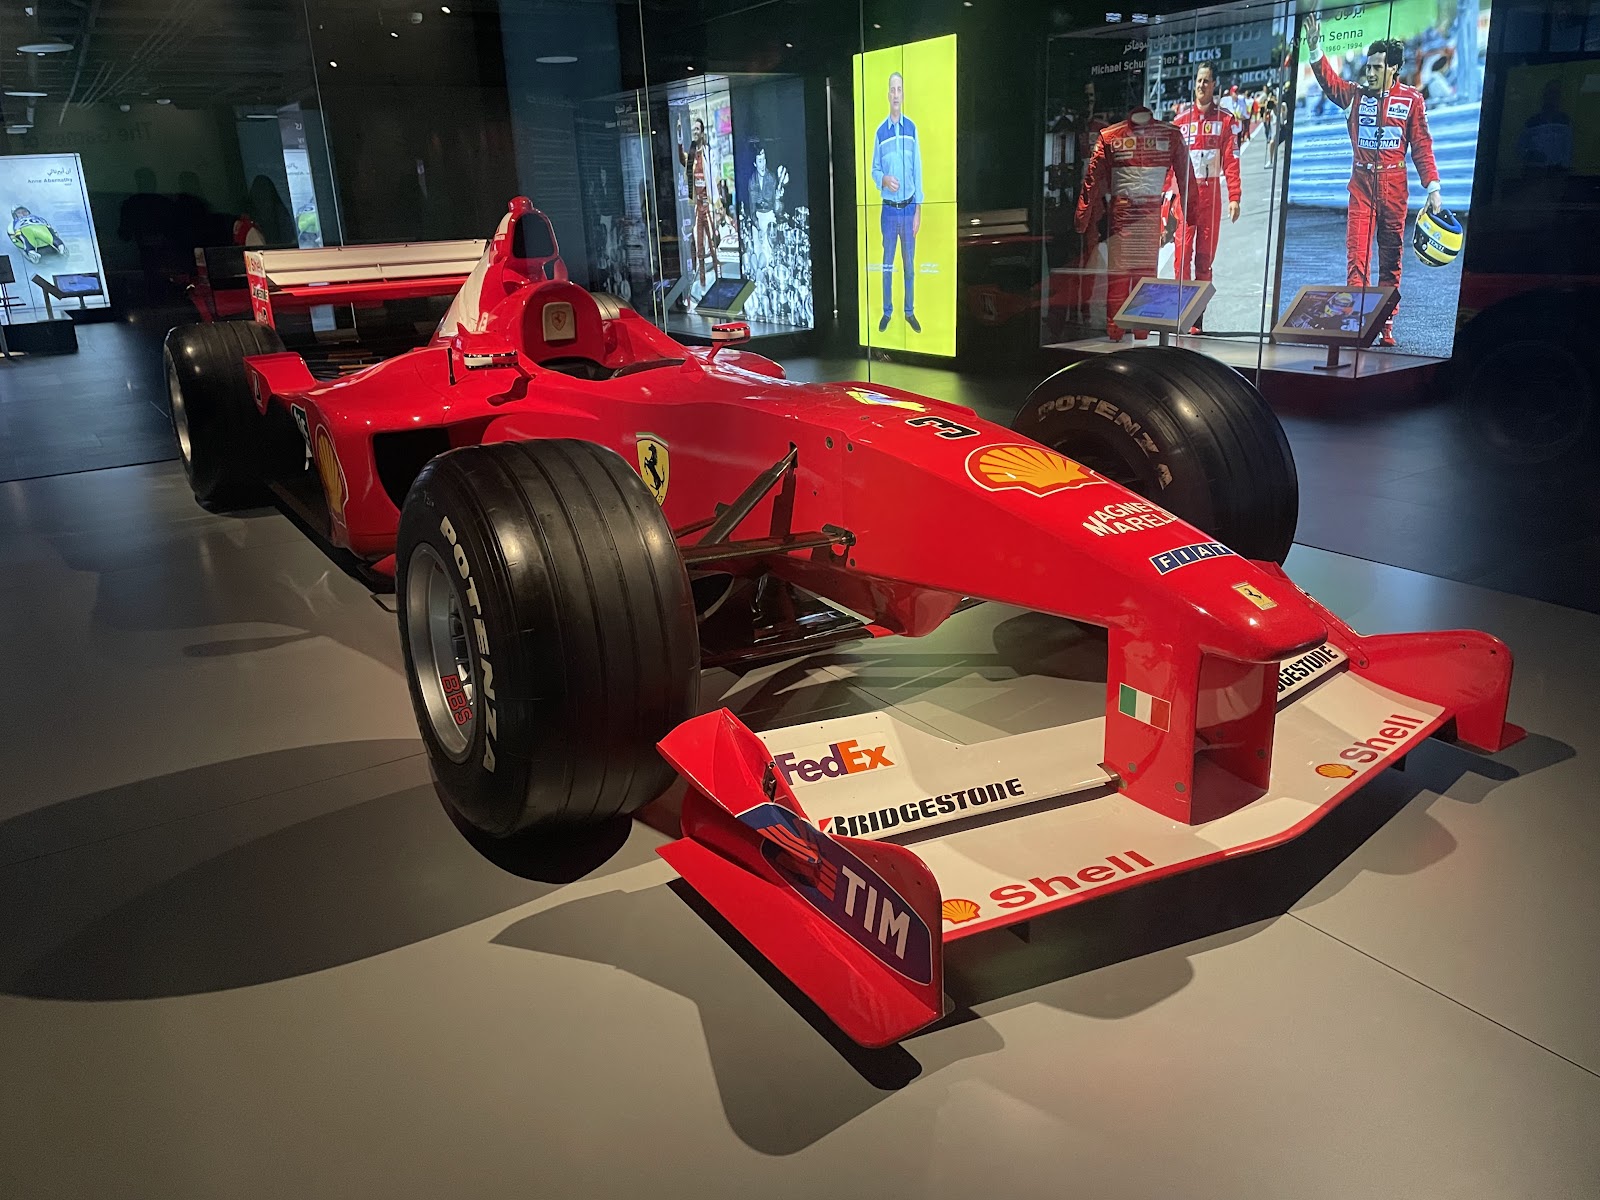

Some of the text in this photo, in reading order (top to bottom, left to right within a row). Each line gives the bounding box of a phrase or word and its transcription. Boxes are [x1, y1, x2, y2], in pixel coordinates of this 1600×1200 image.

[1329, 29, 1364, 41] Senna
[1347, 42, 1363, 50] 1994
[1091, 62, 1122, 75] Michael
[905, 416, 980, 440] 3
[1037, 395, 1173, 490] POTENZA
[1157, 543, 1226, 569] FIAT
[439, 515, 498, 774] POTENZA
[441, 674, 473, 726] BBS
[773, 739, 895, 786] FedEx
[1339, 713, 1425, 764] Shell
[827, 777, 1025, 837] BRIDGESTONE
[989, 850, 1156, 909] Shell
[841, 864, 911, 961] TIM
